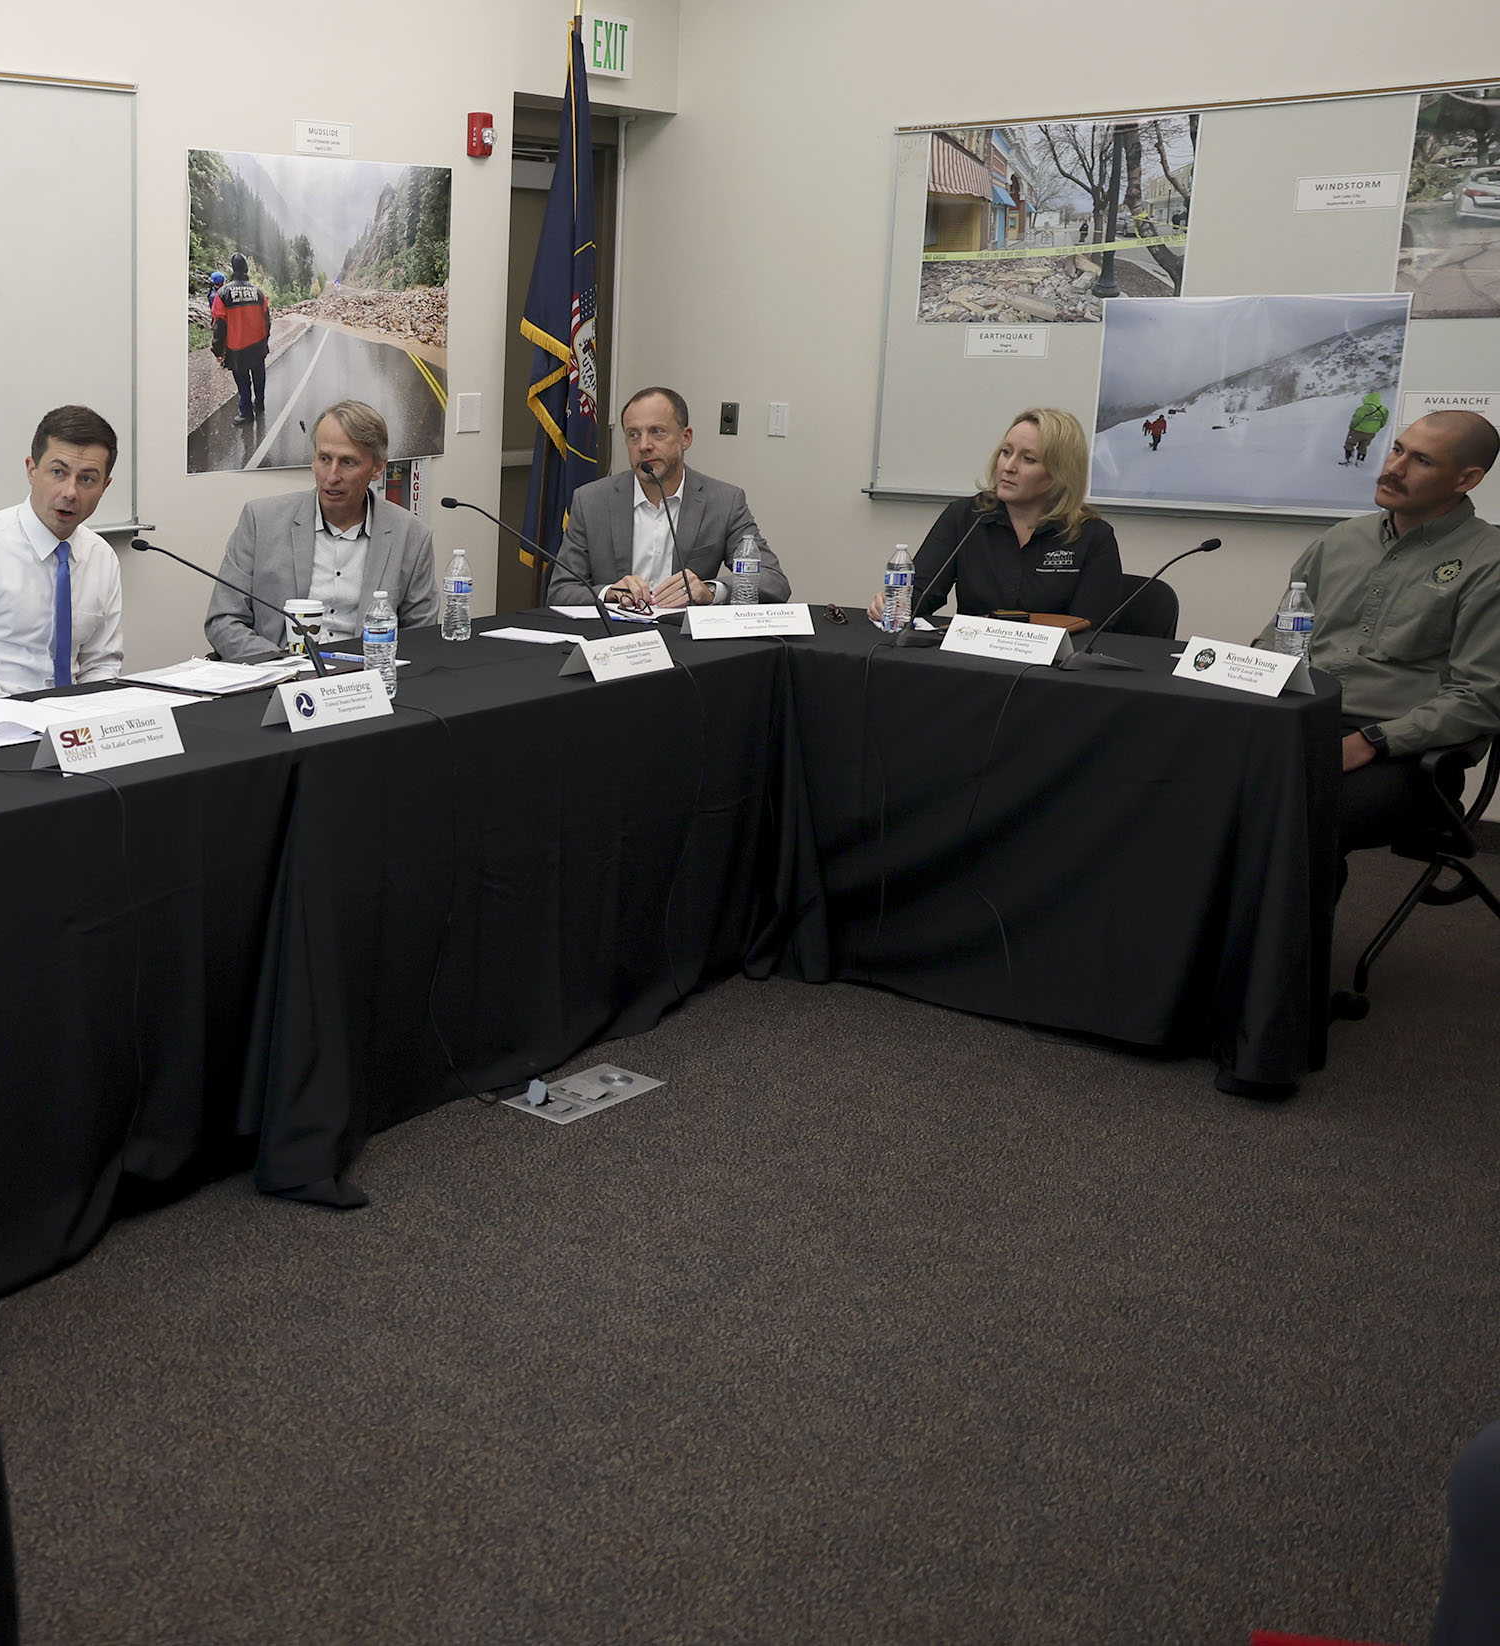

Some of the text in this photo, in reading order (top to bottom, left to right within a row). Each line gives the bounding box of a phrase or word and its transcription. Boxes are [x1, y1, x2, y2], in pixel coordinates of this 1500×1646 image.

[593, 19, 628, 71] EXIT
[308, 127, 339, 137] MUDSLIDE
[1315, 181, 1381, 191] WINDSTORM
[230, 290, 259, 299] FIRE
[979, 333, 1034, 341] EARTHQUAKE
[582, 357, 597, 391] UTAH
[1424, 397, 1491, 405] AVALANCHE
[985, 626, 1013, 637] Kathryn
[1014, 630, 1049, 641] McMullin
[1255, 657, 1278, 671] Young
[320, 682, 372, 696] Pete Buttigieg
[100, 718, 156, 738] Jenny Wilson
[59, 730, 88, 749] SL
[100, 733, 164, 751] Salt Lake County Mayor
[66, 752, 98, 763] COUNTY
